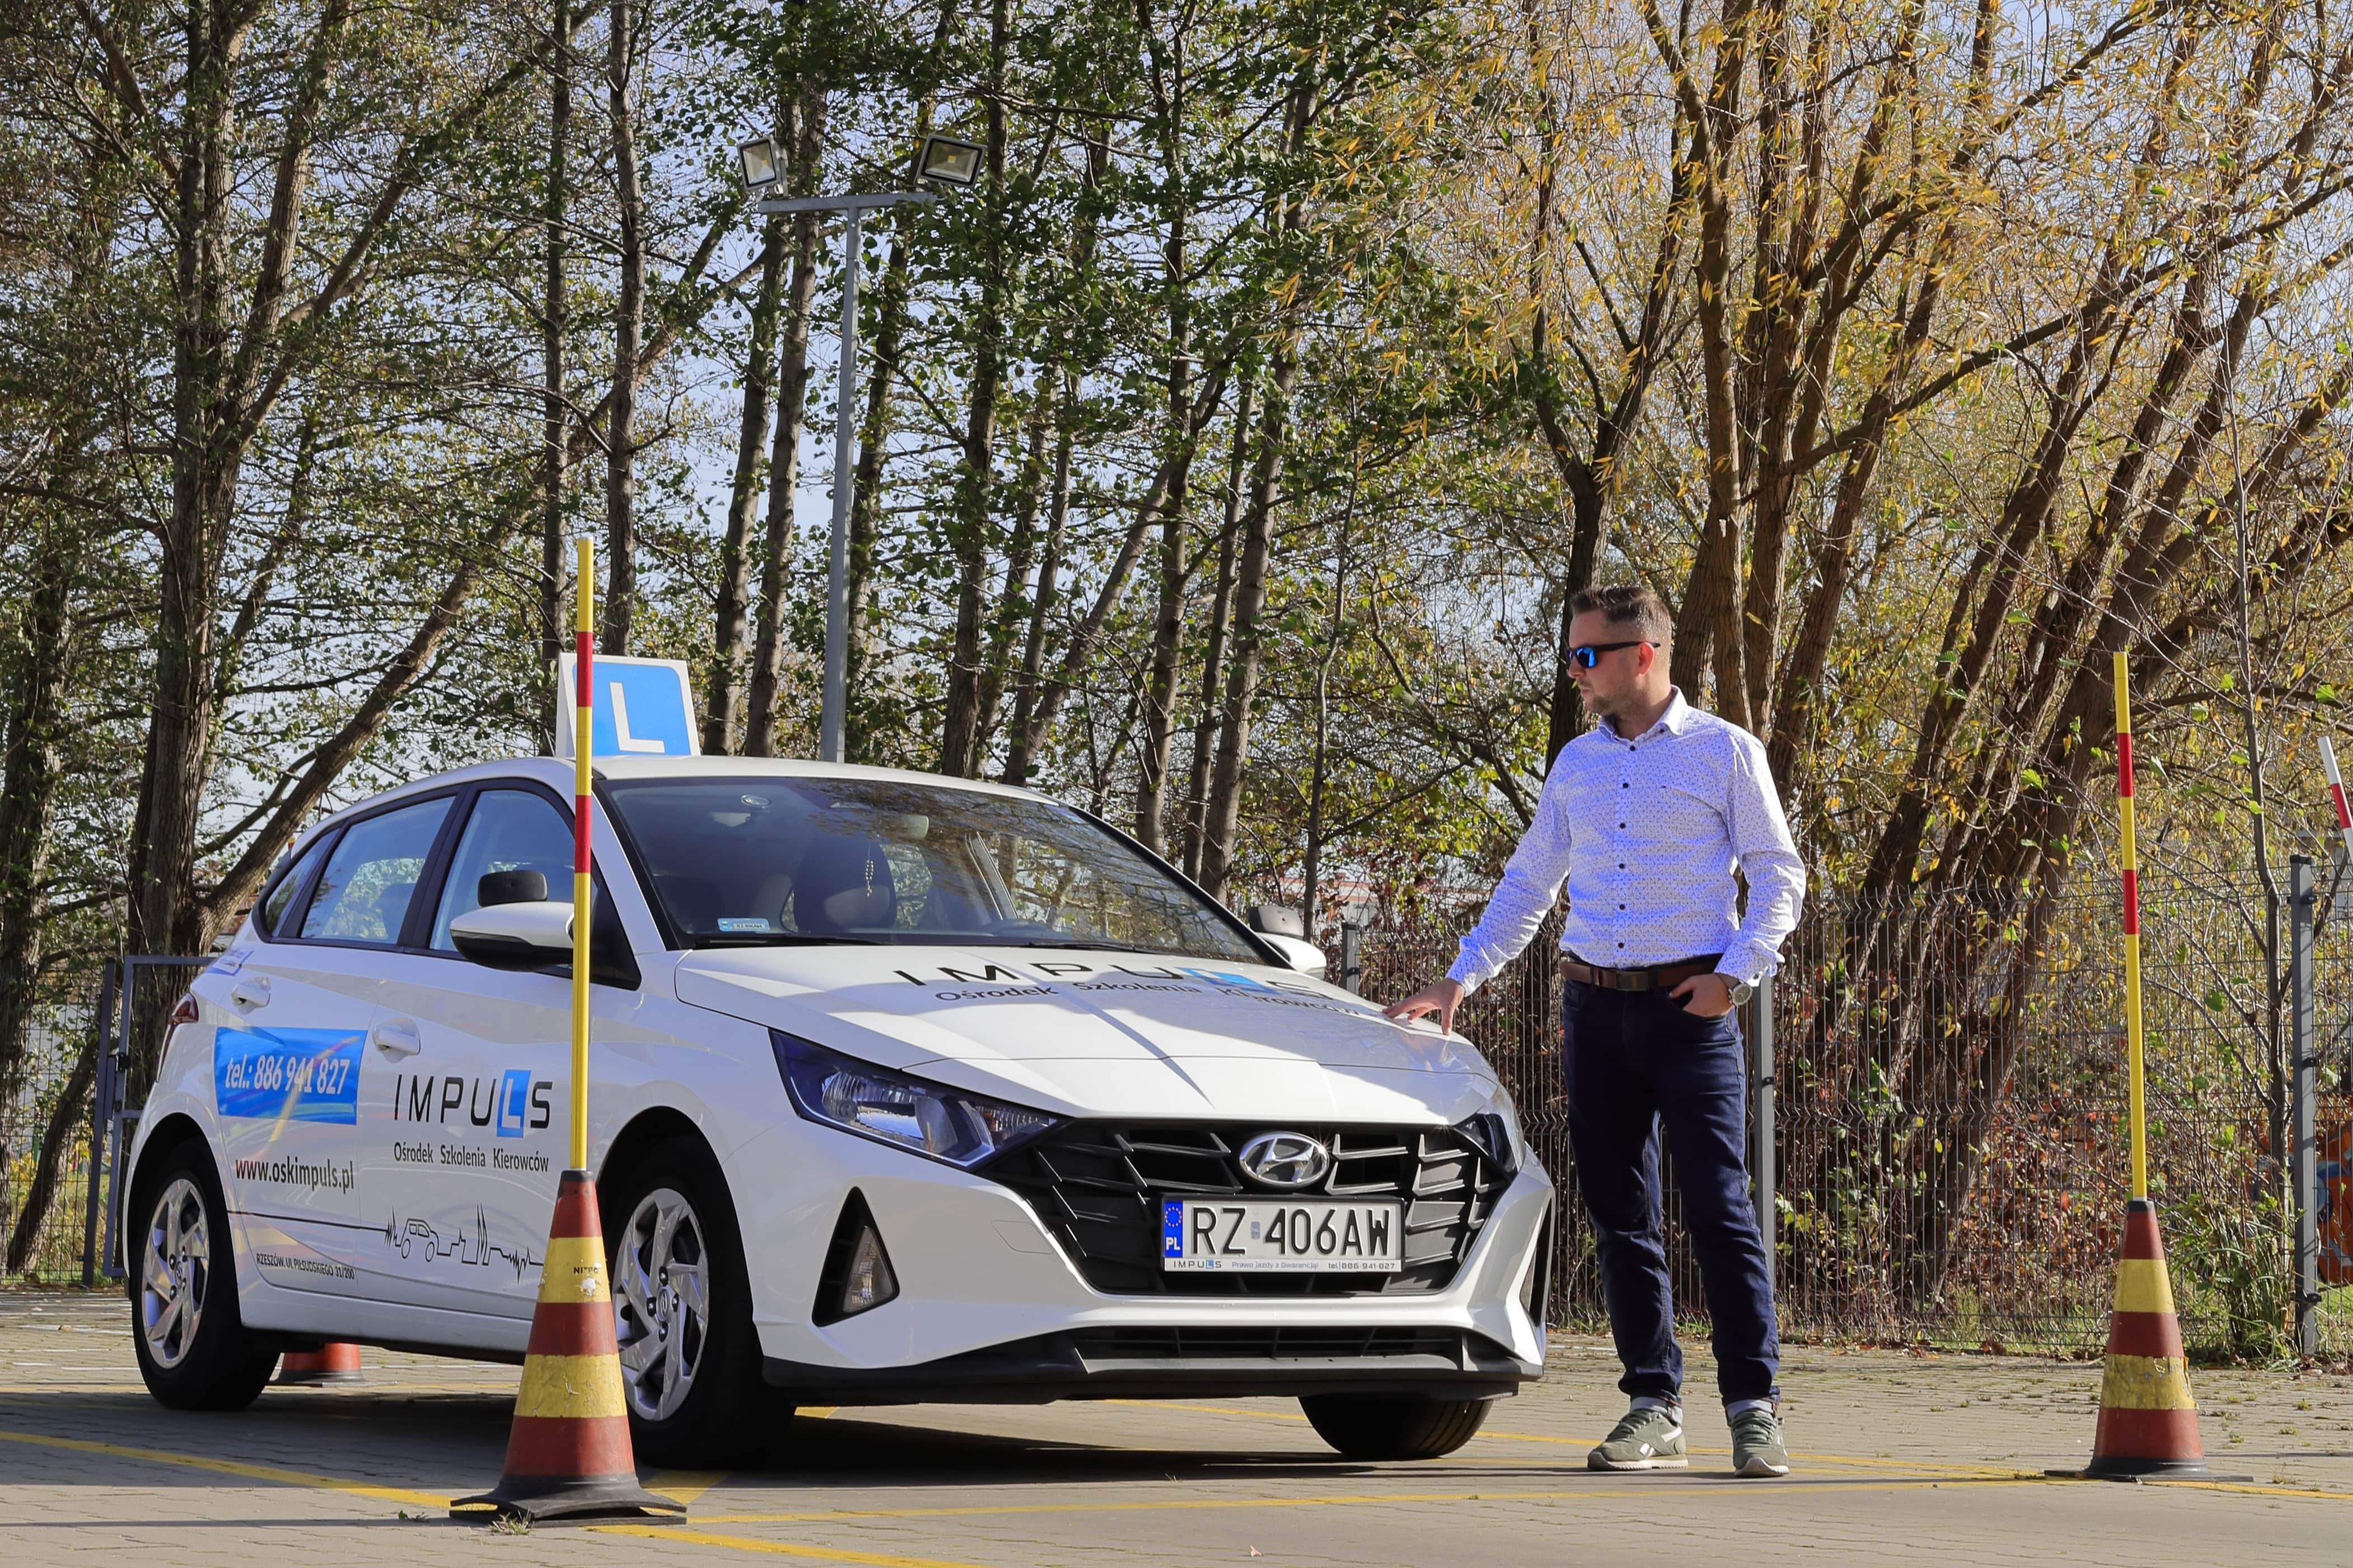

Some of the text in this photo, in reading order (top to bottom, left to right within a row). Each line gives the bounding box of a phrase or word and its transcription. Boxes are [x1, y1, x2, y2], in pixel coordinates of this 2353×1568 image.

[609, 682, 665, 753] L
[893, 962, 1333, 1000] IMPULS
[935, 986, 1060, 1001] Ośrodek
[1072, 982, 1202, 993] Szkolenia
[225, 1053, 350, 1095] tel.: 886 941 827
[394, 1074, 553, 1130] IMPULS
[235, 1155, 354, 1194] www.oskimpuls.pl
[394, 1141, 549, 1173] Ośrodek Szkolenia Kierowców
[1165, 1235, 1181, 1251] PL
[1192, 1207, 1391, 1257] RZ 406AW
[335, 1266, 355, 1280] 31/200
[1173, 1260, 1222, 1270] IMPULS
